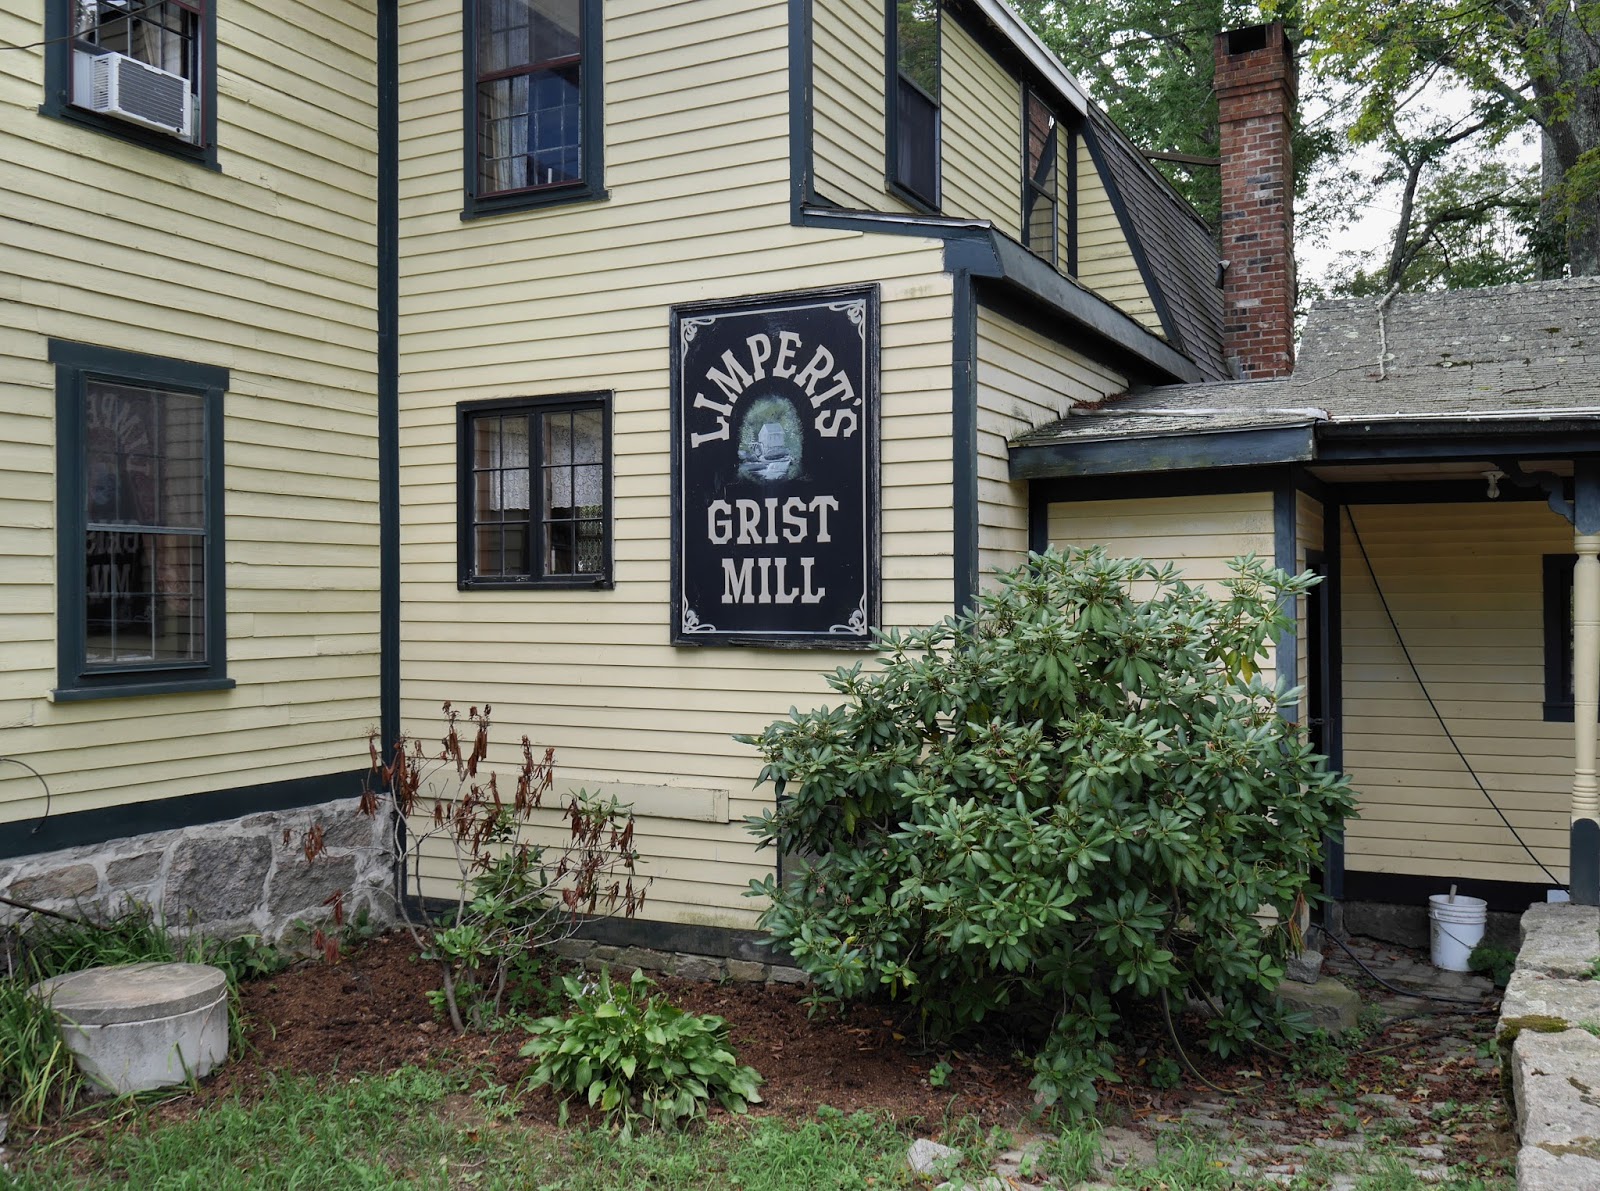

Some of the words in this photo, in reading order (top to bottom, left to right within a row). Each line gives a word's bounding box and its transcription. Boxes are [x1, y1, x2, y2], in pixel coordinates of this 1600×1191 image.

[691, 331, 862, 448] LIMPERT'S
[707, 495, 839, 545] GRIST
[721, 557, 825, 604] MILL
